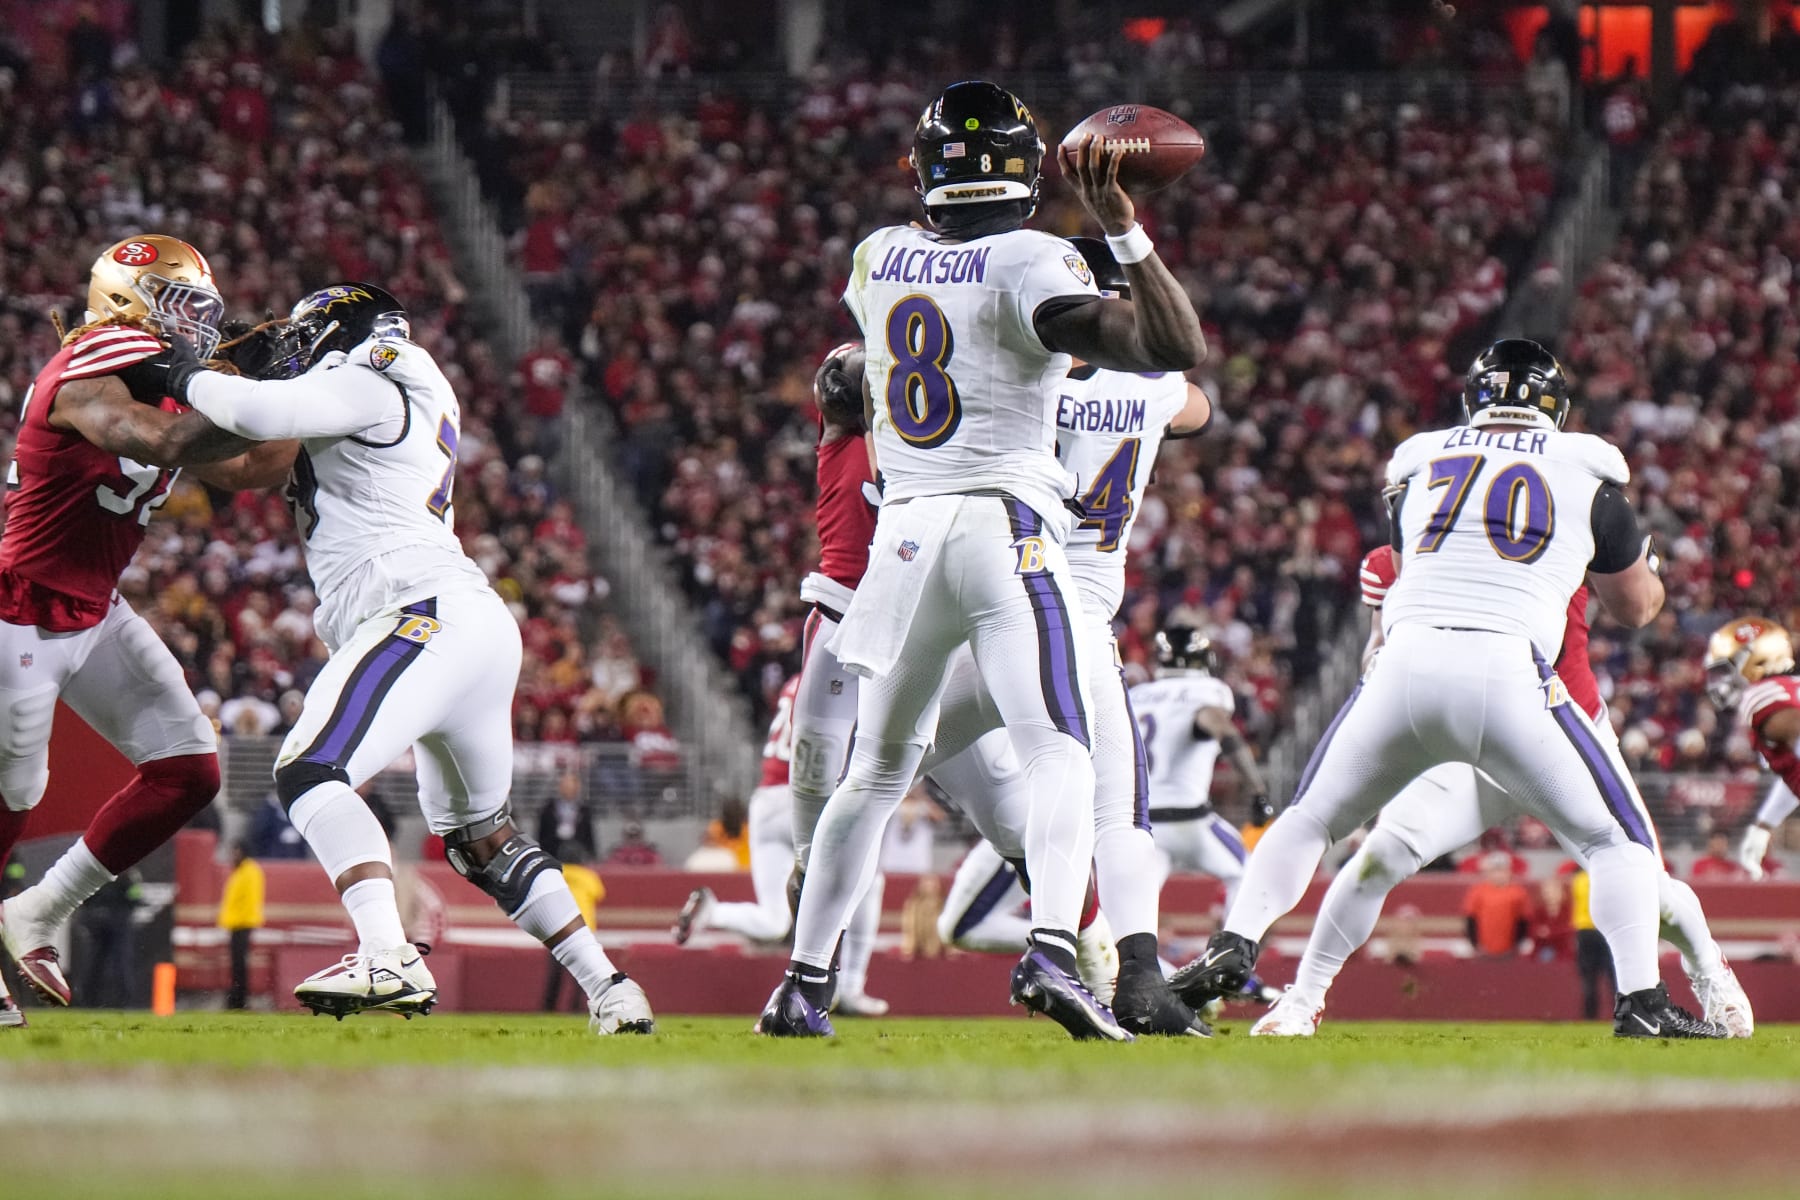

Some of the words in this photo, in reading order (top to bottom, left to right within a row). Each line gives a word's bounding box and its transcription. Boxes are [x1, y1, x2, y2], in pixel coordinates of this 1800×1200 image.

[980, 153, 992, 173] 8
[944, 187, 1007, 200] RAVENS
[871, 246, 991, 284] JACKSON
[885, 293, 962, 449] 8
[1499, 383, 1530, 400] 70
[1056, 394, 1145, 432] ERBAUM
[1416, 454, 1556, 565] 70
[1009, 536, 1046, 574] B
[393, 614, 442, 644] B
